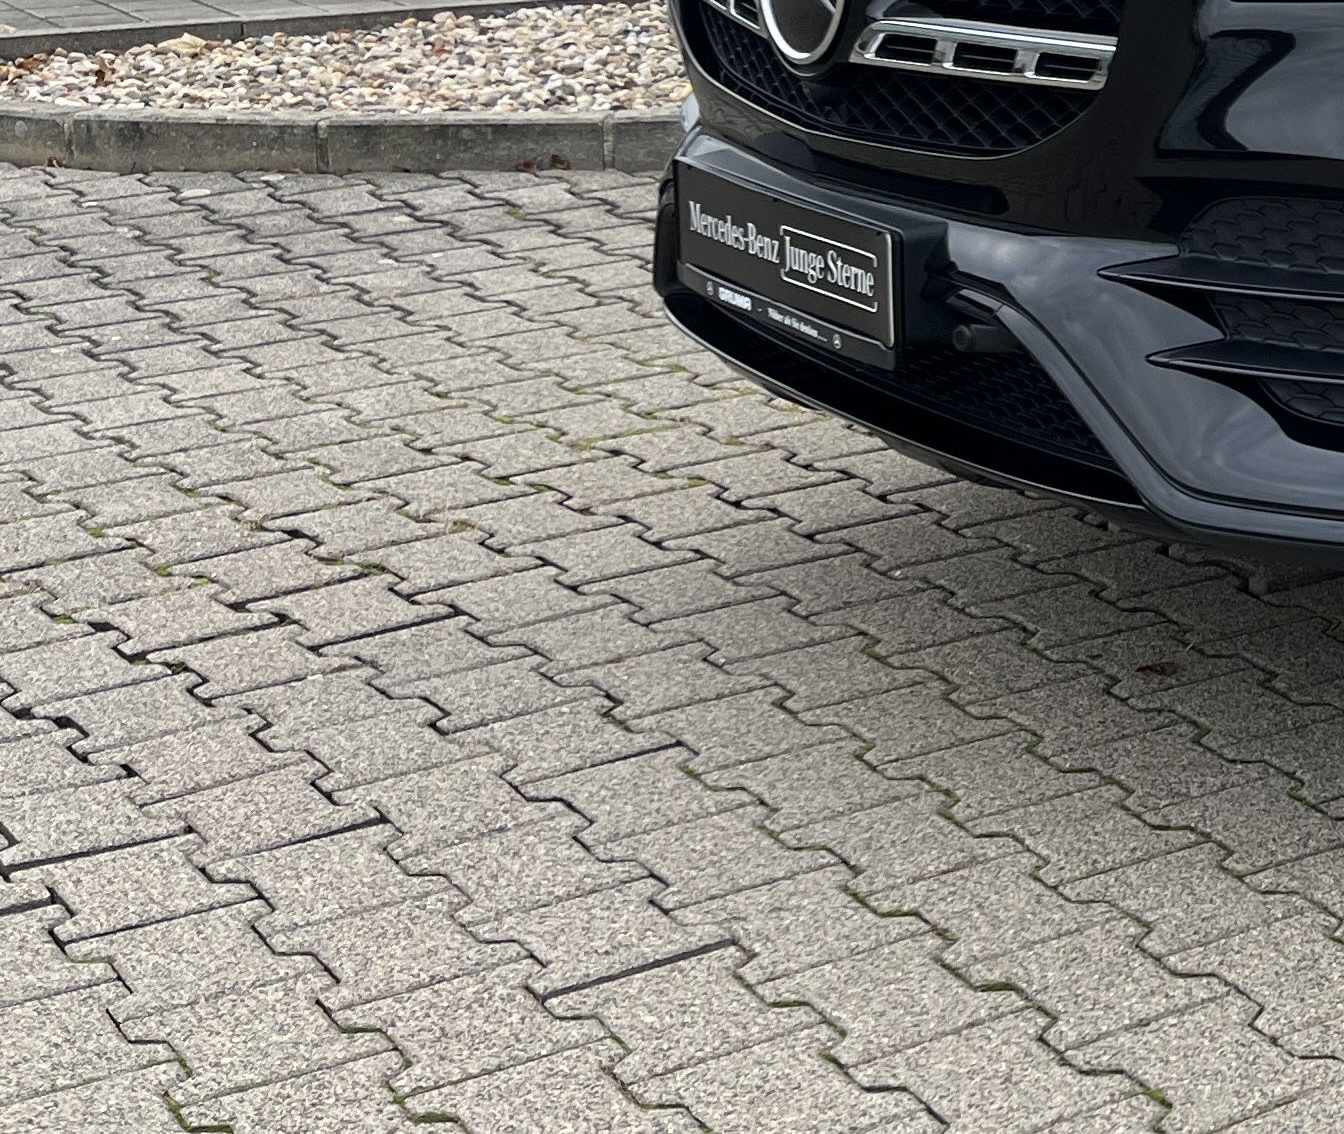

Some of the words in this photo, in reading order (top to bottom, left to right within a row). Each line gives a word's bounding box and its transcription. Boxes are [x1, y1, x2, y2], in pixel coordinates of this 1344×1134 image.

[688, 200, 780, 264] Mercedes-Benz
[783, 236, 825, 284] Junge
[827, 250, 875, 297] Sterne
